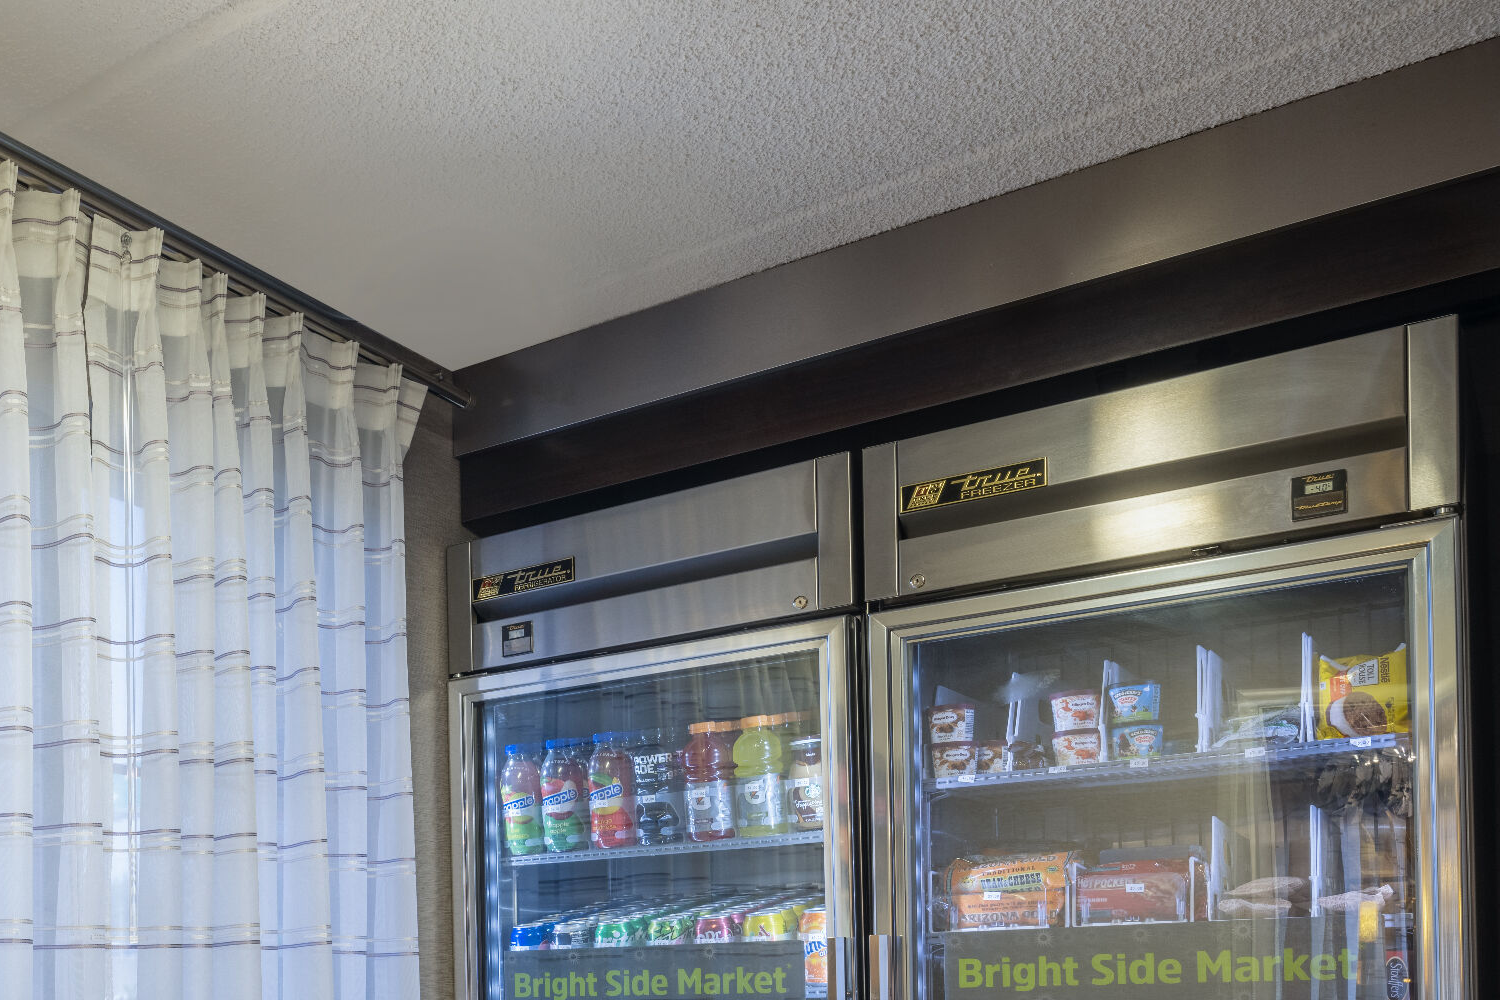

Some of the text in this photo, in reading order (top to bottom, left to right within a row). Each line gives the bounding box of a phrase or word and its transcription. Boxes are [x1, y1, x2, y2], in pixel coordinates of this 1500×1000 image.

[961, 479, 1036, 499] FREEZER
[514, 967, 787, 1000] Bright Side Market
[958, 947, 1355, 992] Bright Side Market
